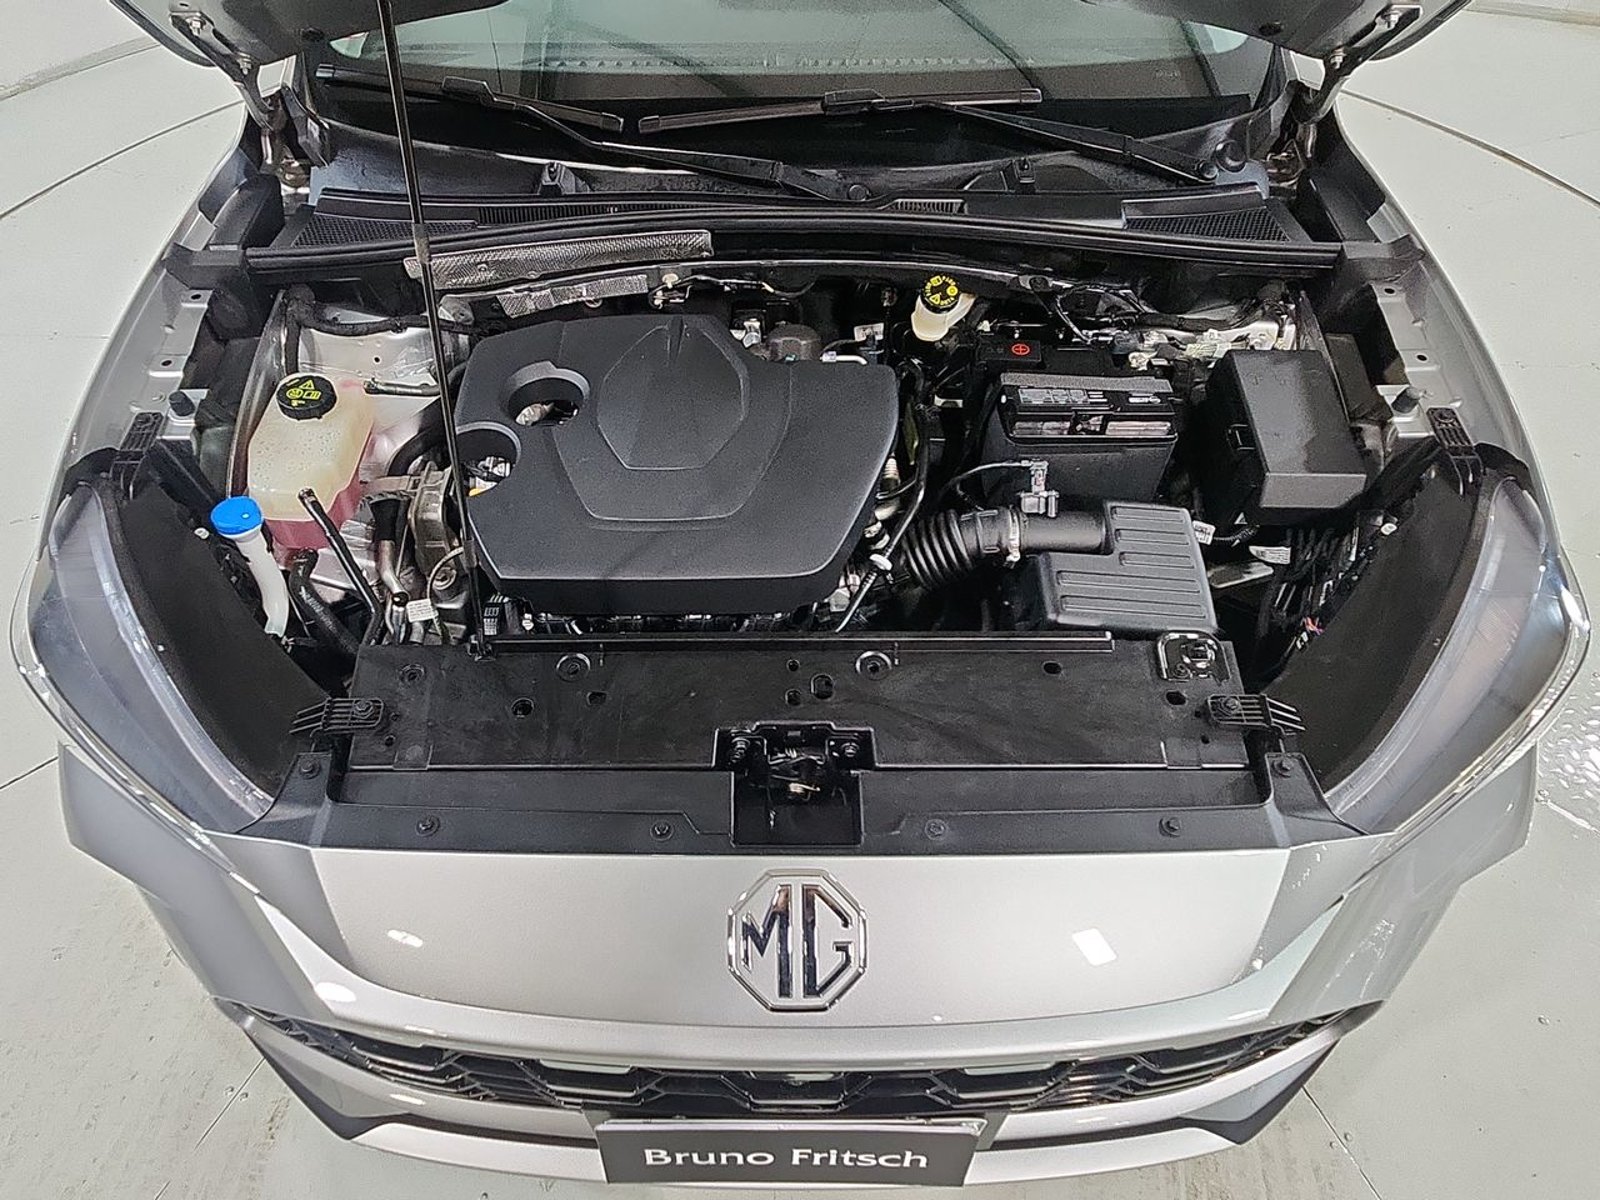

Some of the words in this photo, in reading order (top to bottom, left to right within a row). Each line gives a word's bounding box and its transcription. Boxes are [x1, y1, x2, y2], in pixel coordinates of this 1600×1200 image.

[741, 884, 852, 998] MG
[644, 1148, 776, 1167] Bruno
[791, 1148, 928, 1169] Fritsch
